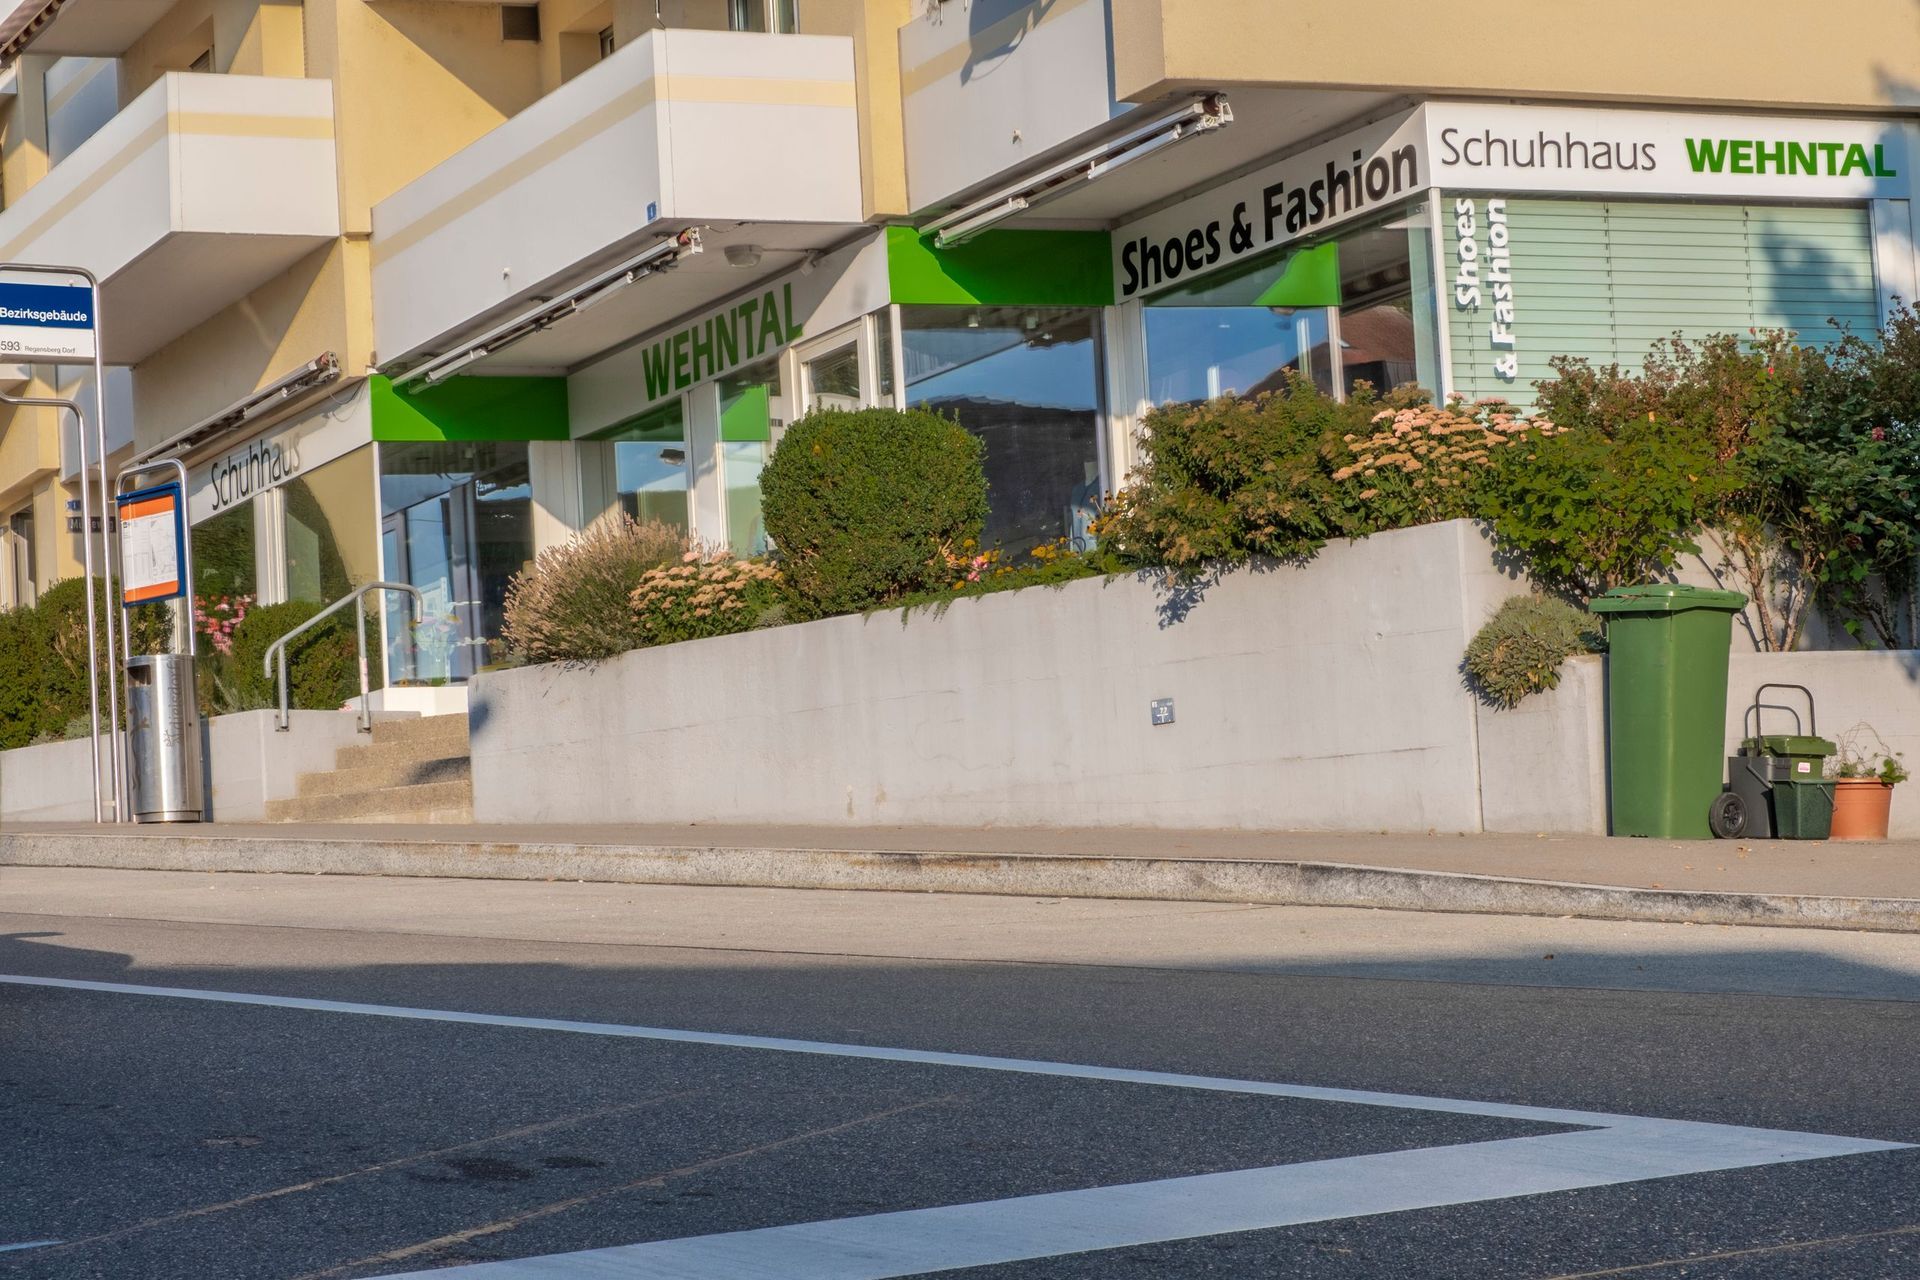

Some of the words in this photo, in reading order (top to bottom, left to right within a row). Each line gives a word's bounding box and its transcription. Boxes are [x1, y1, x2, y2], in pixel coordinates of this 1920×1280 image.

[1440, 127, 1657, 172] Schuhhaus
[1685, 137, 1897, 178] WEHNTAL
[1121, 220, 1221, 296] Shoes
[1229, 201, 1254, 254] &
[1262, 143, 1419, 243] Fashion
[1456, 198, 1482, 306] Shoes
[1487, 198, 1516, 343] Fashion
[0, 307, 87, 322] Bezirksgebäude
[0, 340, 20, 352] 593
[24, 345, 61, 354] Regensberg
[61, 346, 76, 354] Dorf
[641, 281, 803, 402] WEHNTAL
[1496, 352, 1519, 378] &
[211, 431, 301, 511] Schuhhaus
